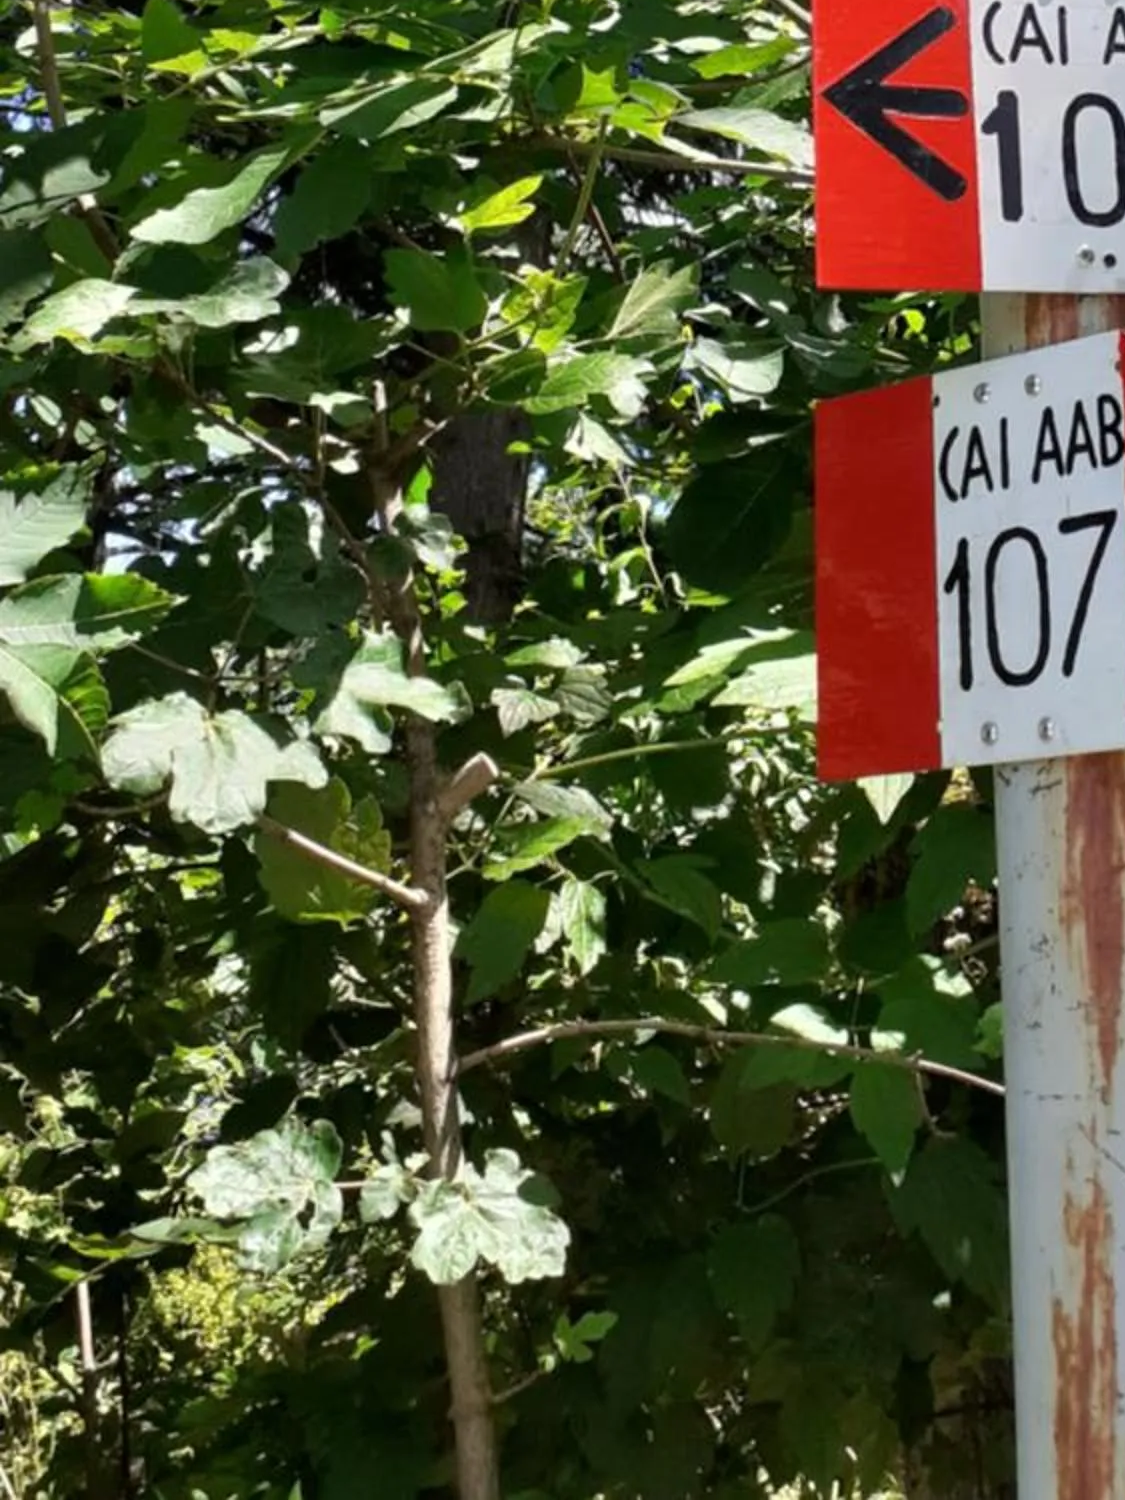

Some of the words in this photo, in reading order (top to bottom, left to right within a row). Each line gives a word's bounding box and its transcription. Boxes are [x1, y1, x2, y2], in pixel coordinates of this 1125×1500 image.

[982, 1, 1070, 67] CAI
[939, 416, 1010, 502] CAI
[1031, 393, 1125, 485] AAB
[943, 509, 1117, 692] 107
